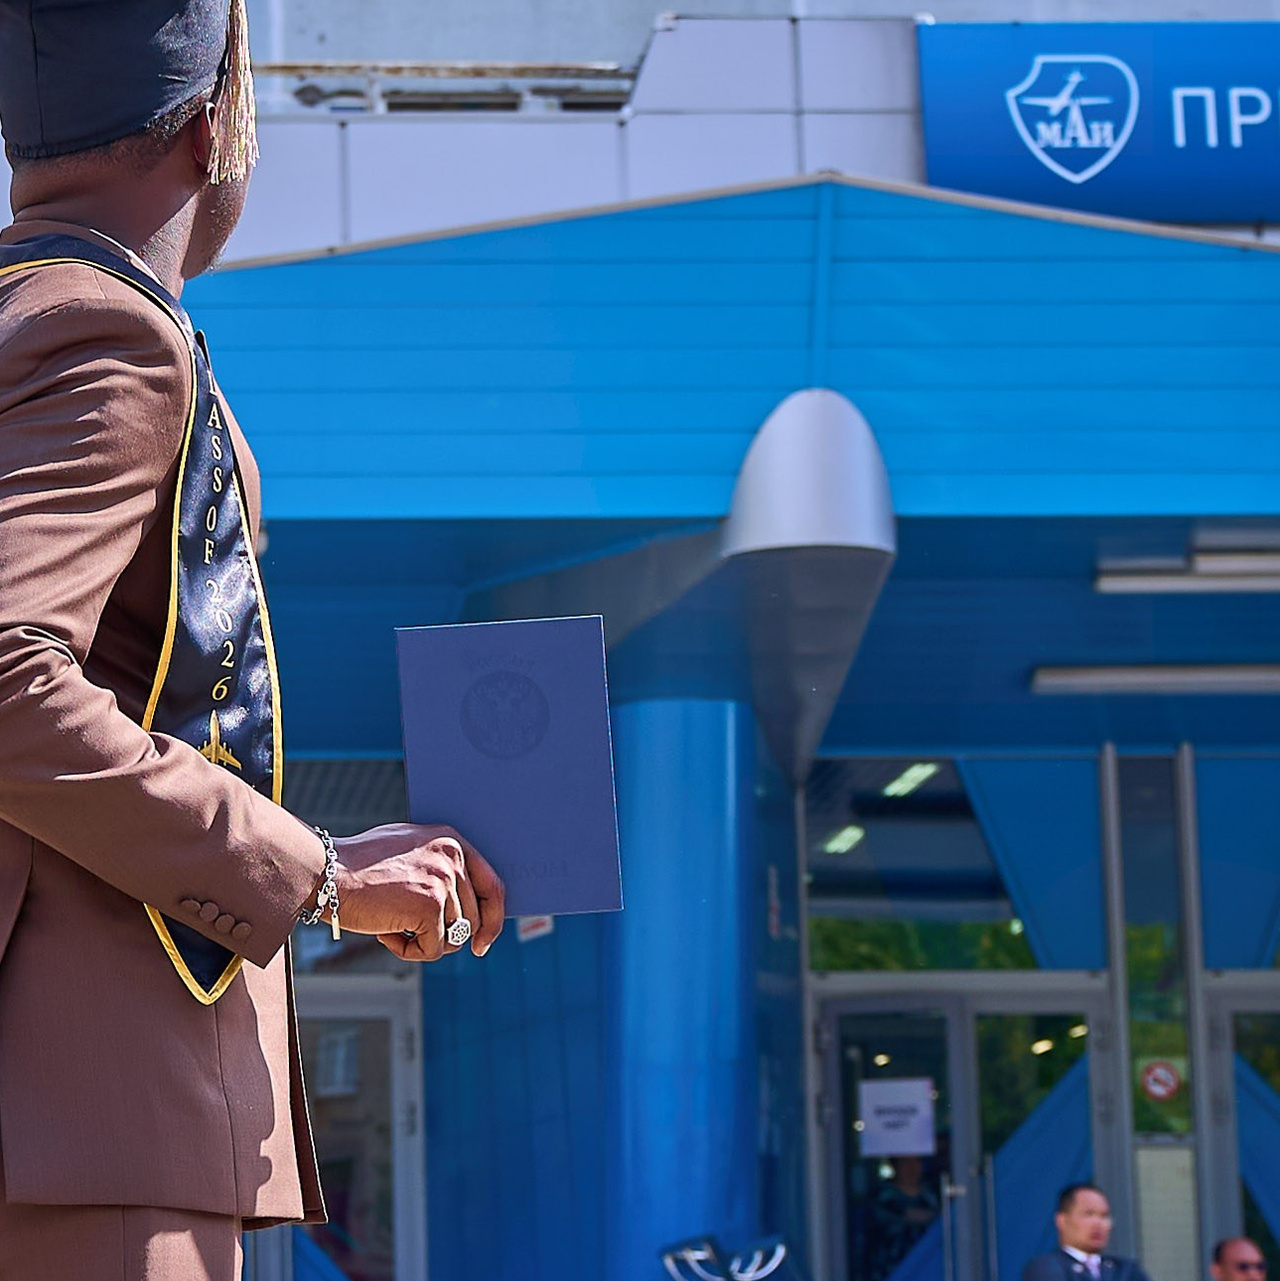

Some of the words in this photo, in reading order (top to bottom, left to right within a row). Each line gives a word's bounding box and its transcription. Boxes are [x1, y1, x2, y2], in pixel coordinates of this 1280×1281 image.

[206, 369, 223, 493] LASS
[203, 505, 218, 565] OF
[205, 579, 235, 701] 2026
